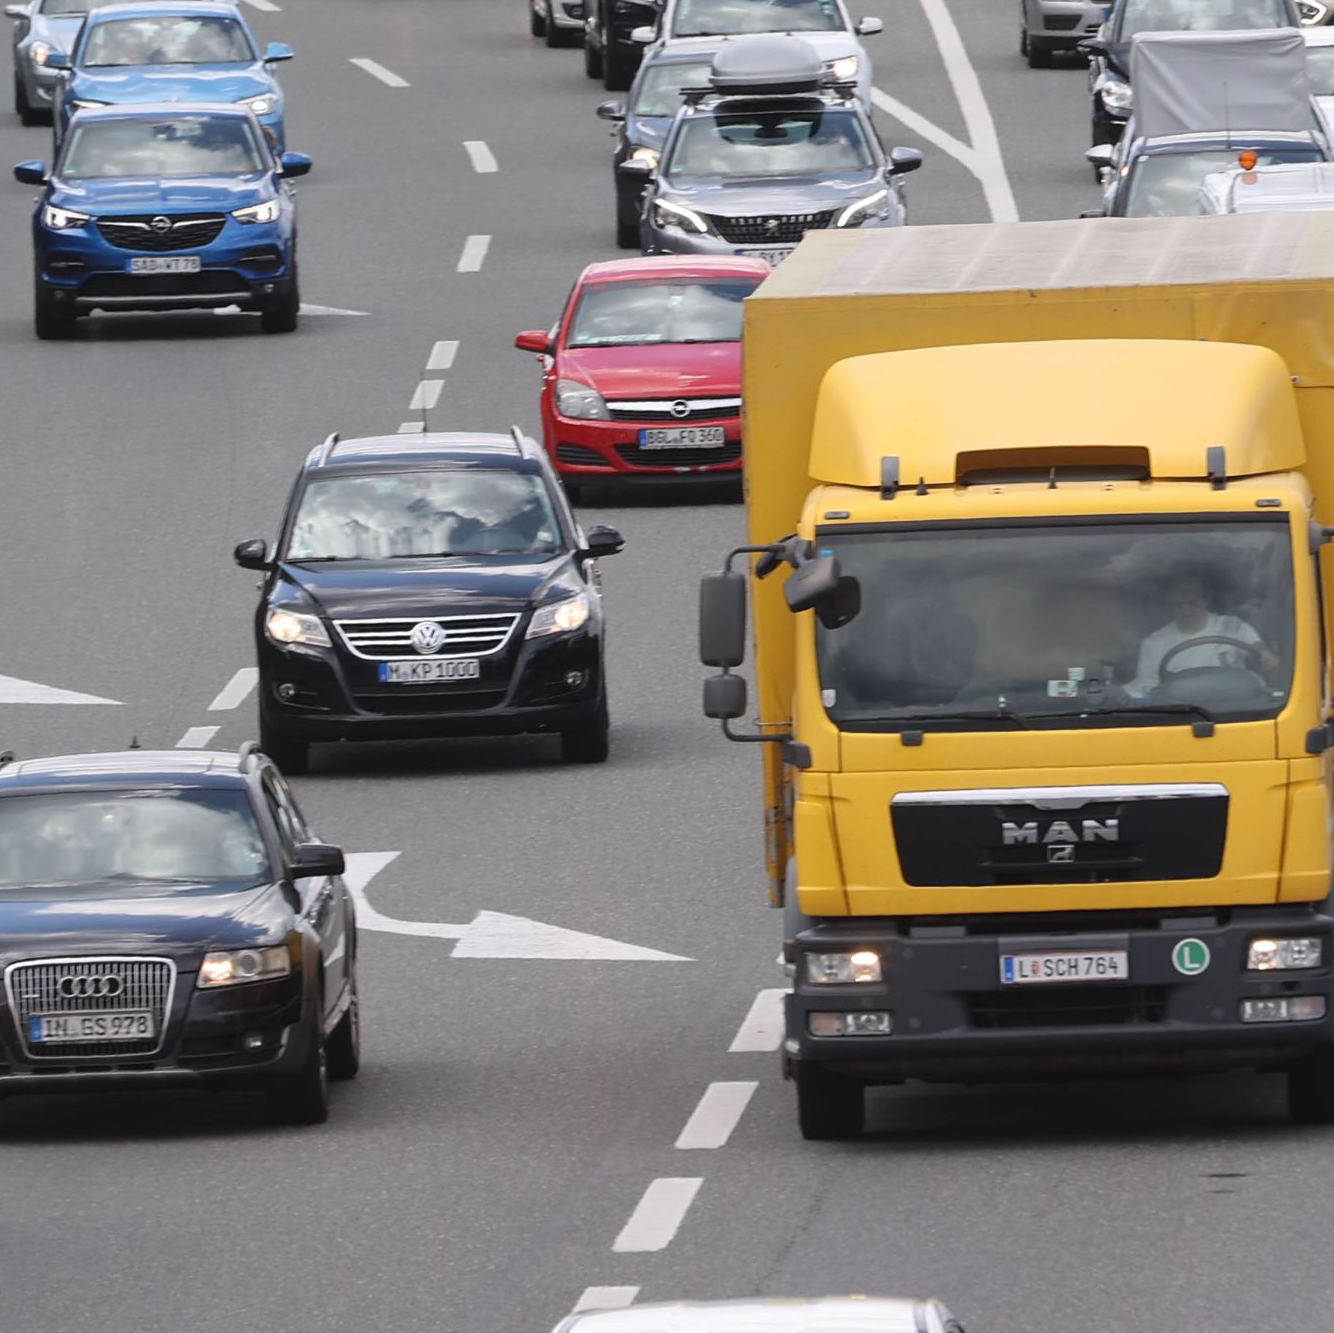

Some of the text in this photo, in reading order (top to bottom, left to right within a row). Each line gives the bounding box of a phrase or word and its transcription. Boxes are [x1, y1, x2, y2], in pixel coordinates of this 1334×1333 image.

[648, 431, 672, 444] BGL
[412, 662, 432, 679] KP
[436, 661, 477, 678] 1000
[1002, 819, 1119, 844] MAN
[1084, 956, 1118, 975] 764
[112, 1016, 148, 1035] 978
